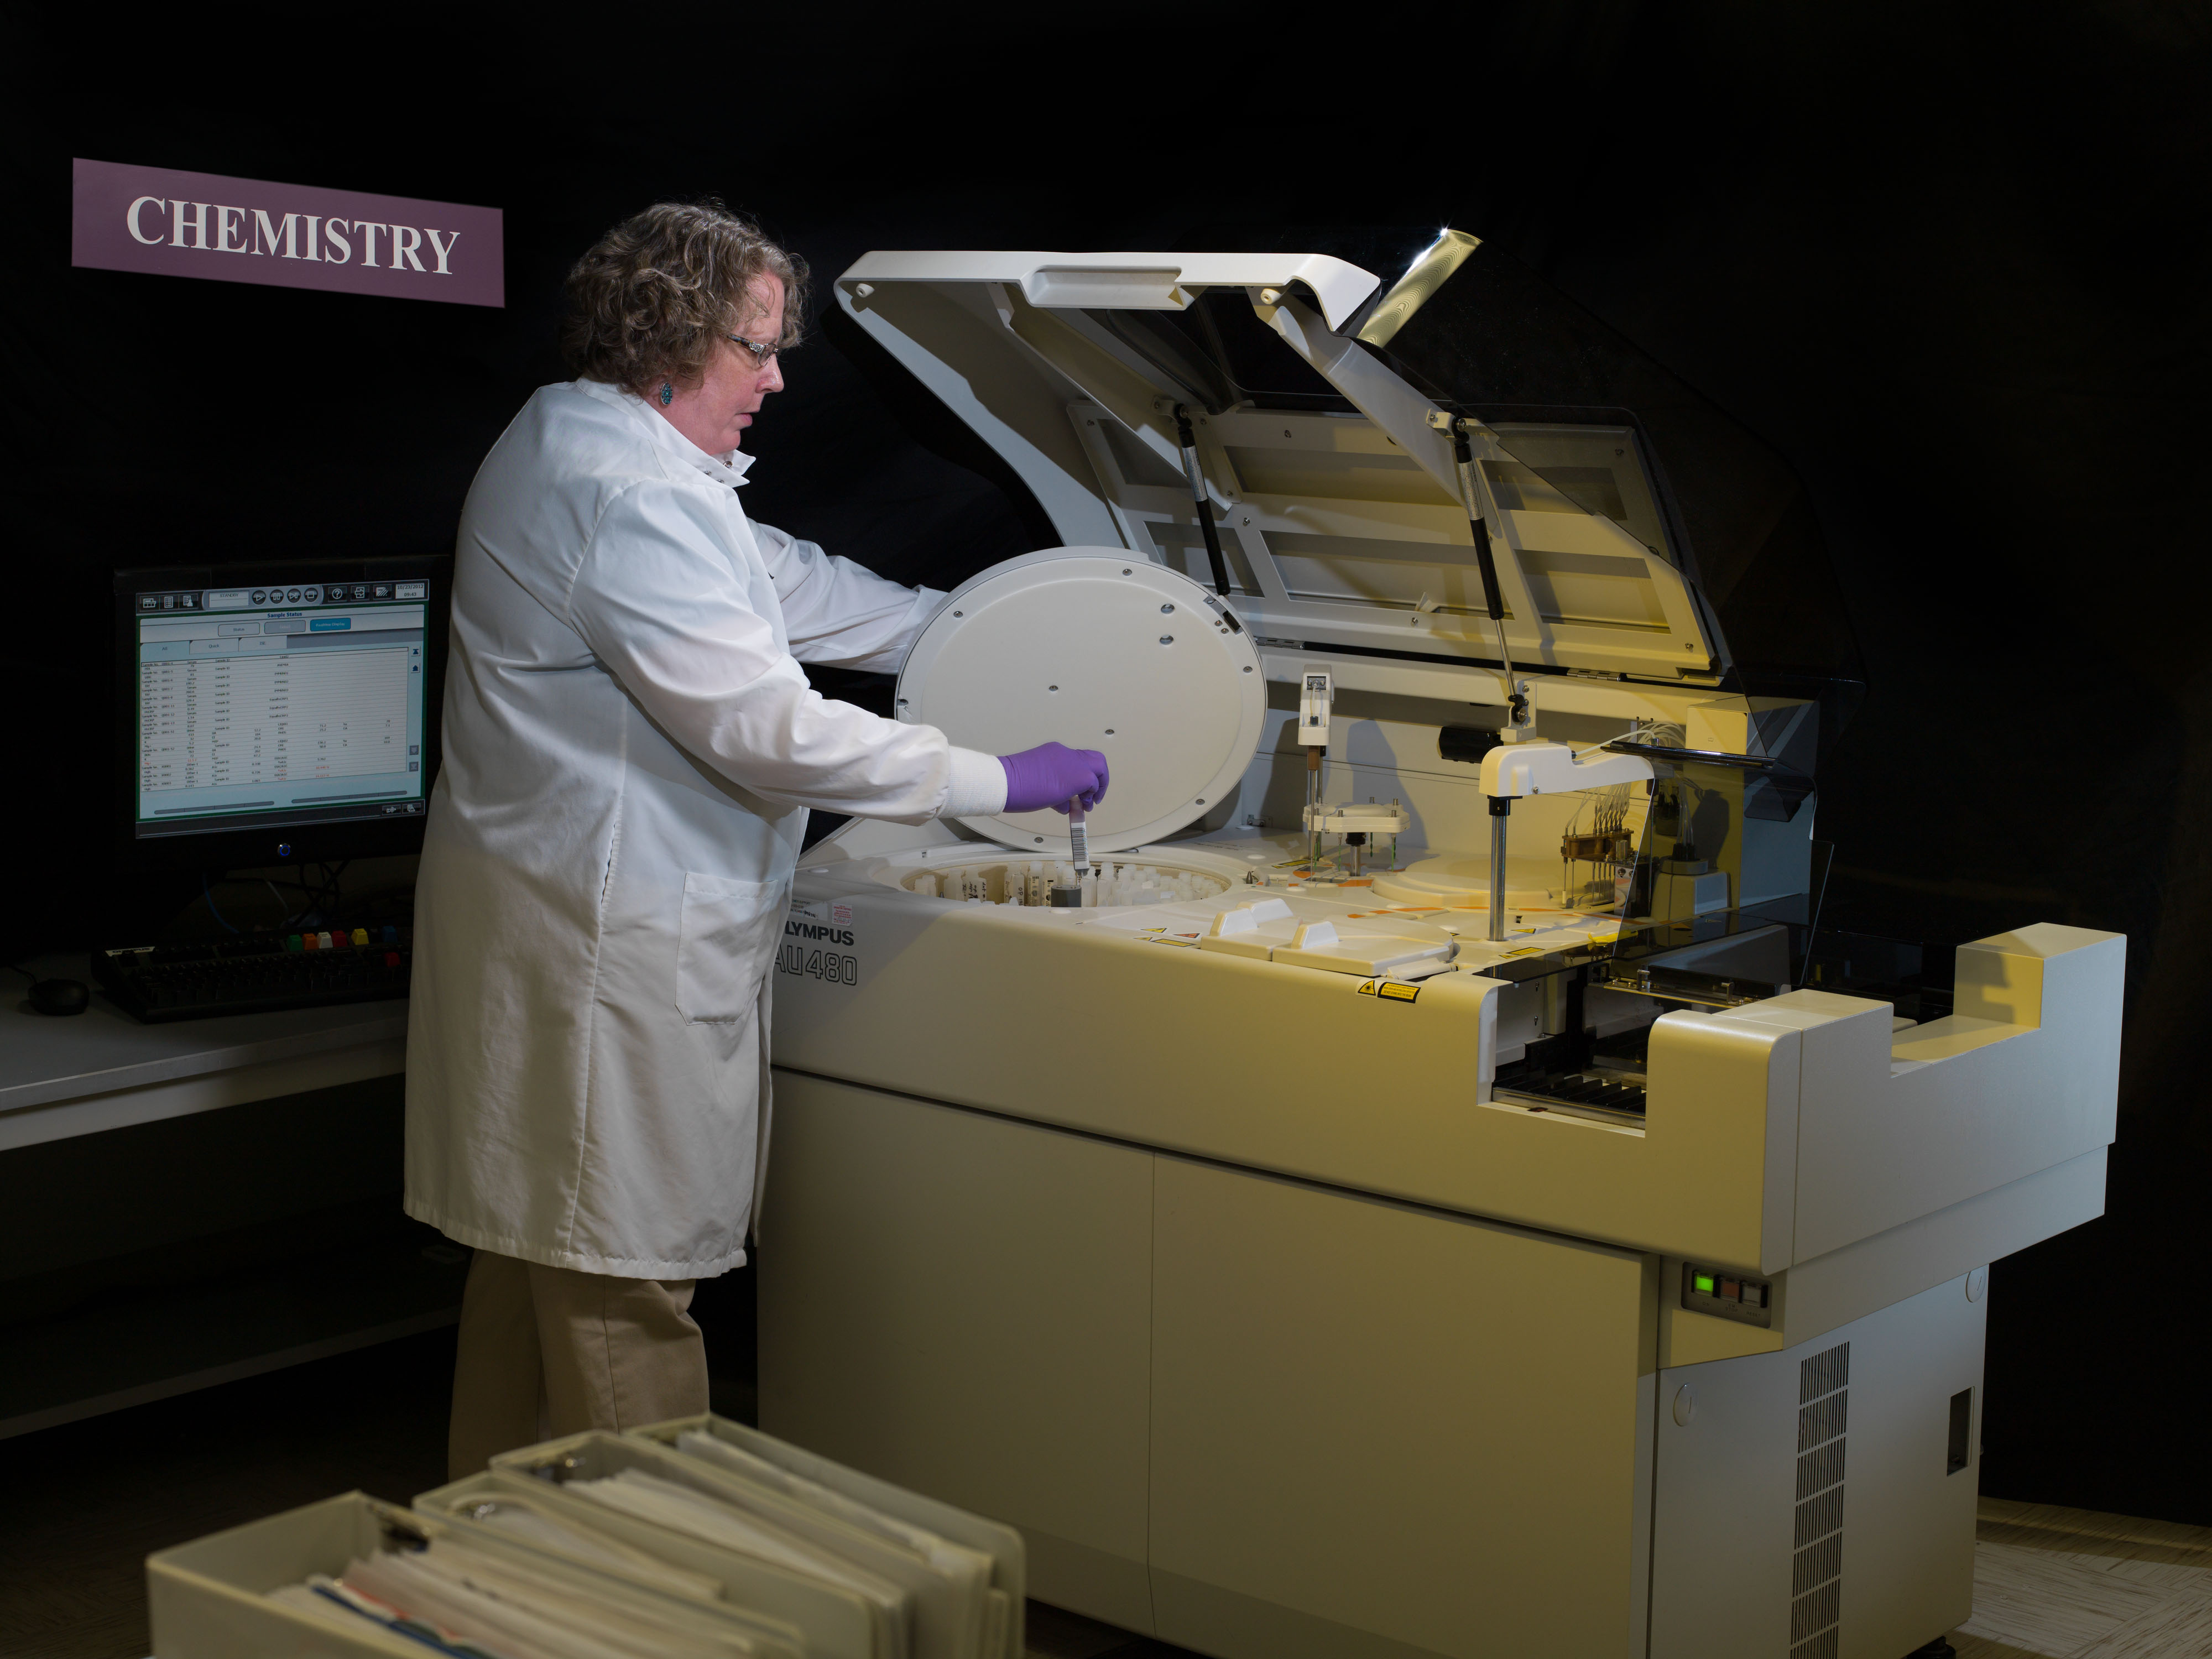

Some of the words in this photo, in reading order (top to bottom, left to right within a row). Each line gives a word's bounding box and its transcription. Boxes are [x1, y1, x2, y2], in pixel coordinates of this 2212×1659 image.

[127, 196, 460, 275] CHEMISTRY
[785, 921, 854, 946] LYMPUS
[775, 944, 857, 986] AU480
